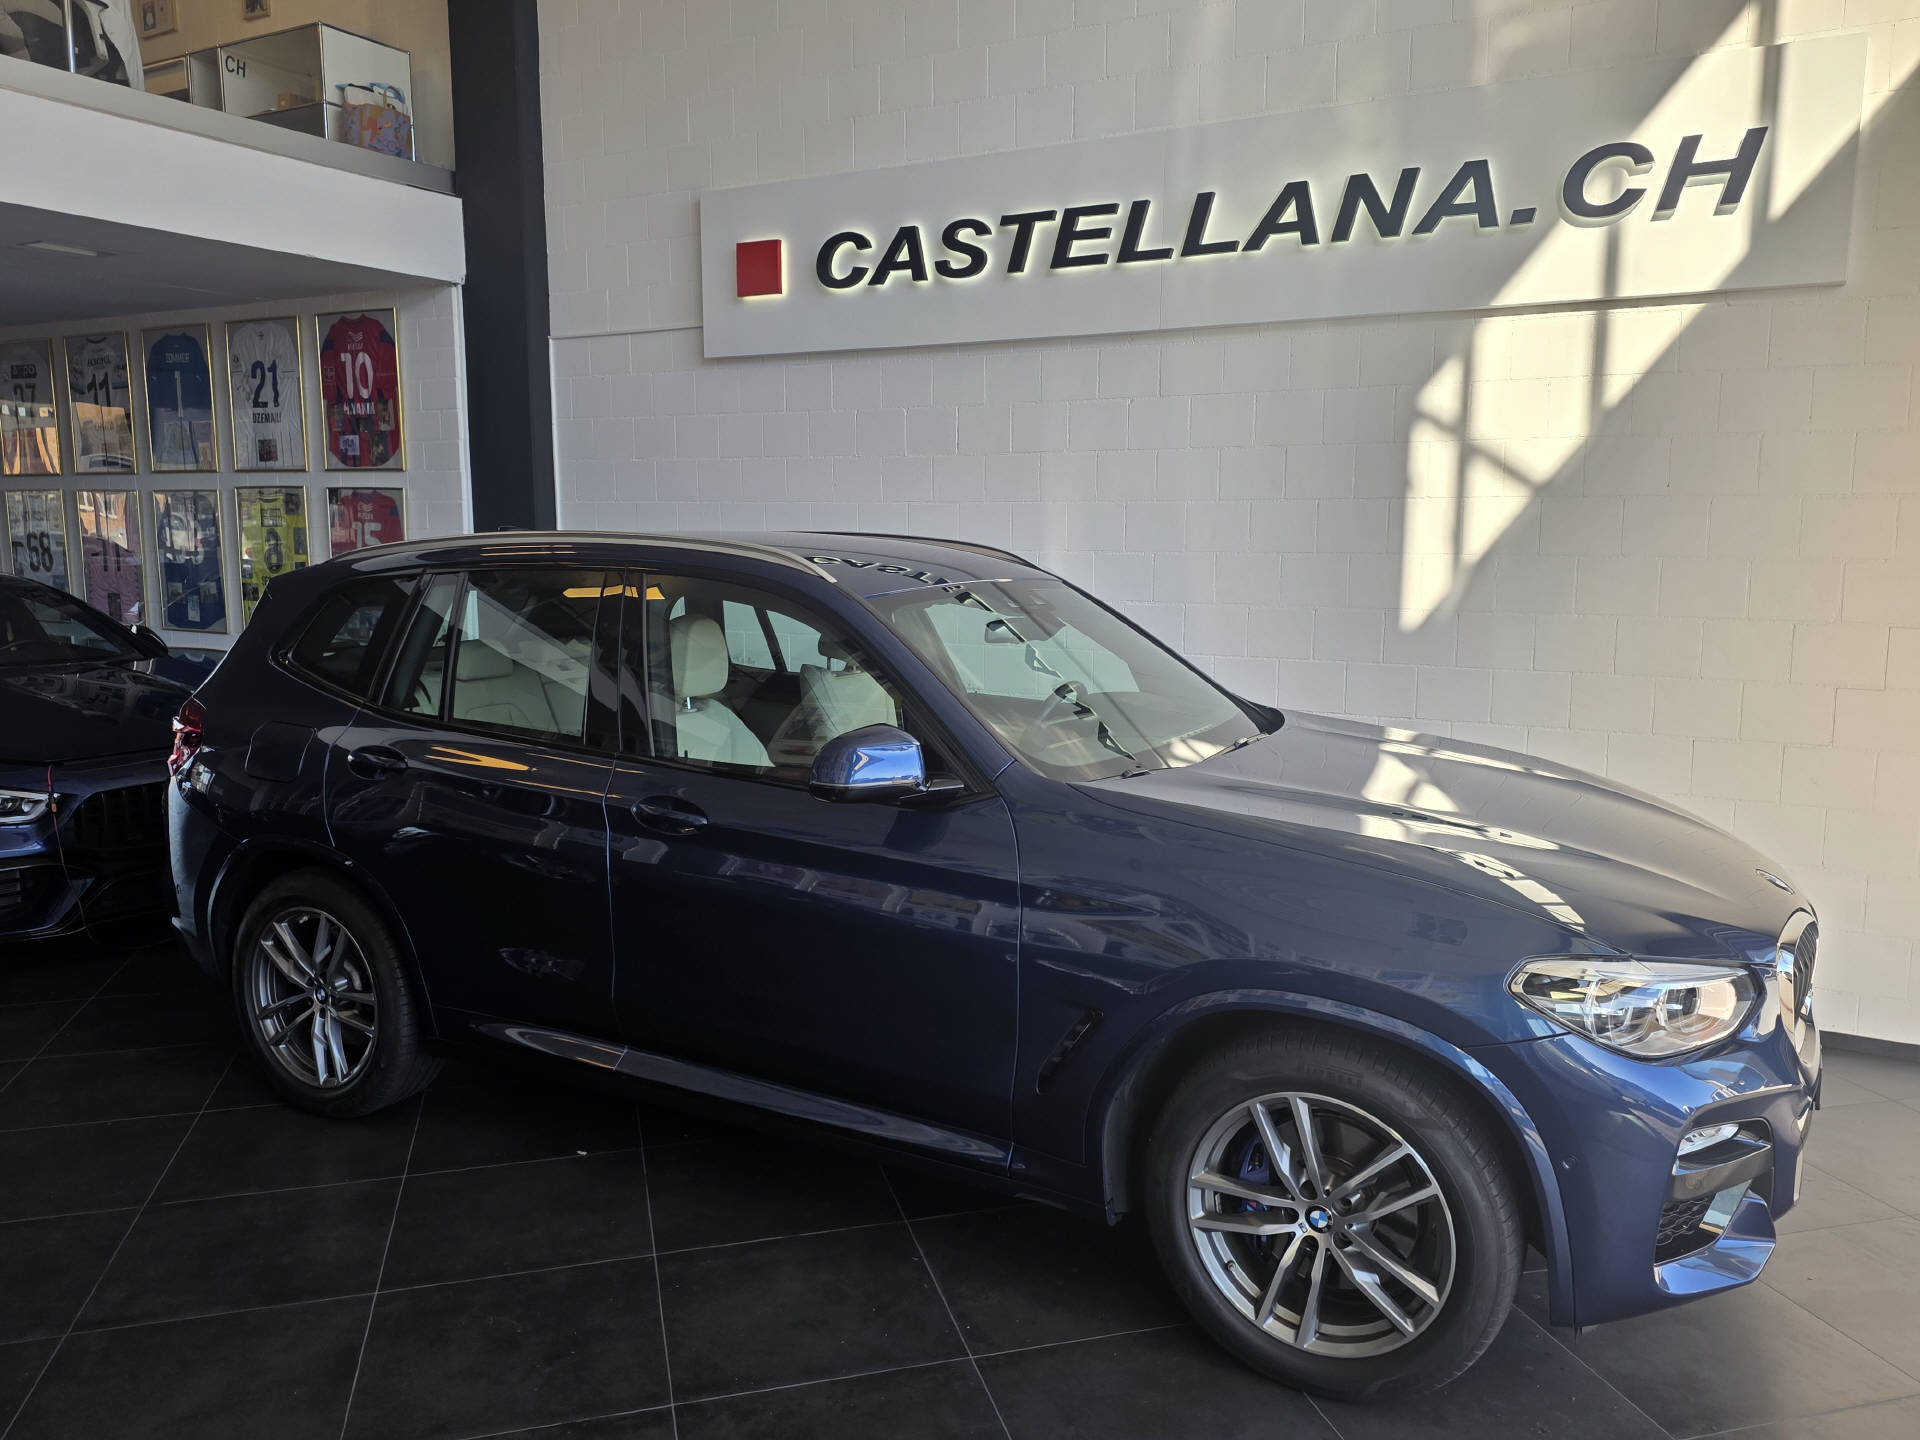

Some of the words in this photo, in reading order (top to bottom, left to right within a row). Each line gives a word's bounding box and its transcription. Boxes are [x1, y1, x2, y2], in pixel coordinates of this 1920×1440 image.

[225, 55, 246, 78] CH
[816, 127, 1768, 289] CASTELLANA.CH
[251, 359, 281, 408] 21
[341, 352, 374, 399] 10
